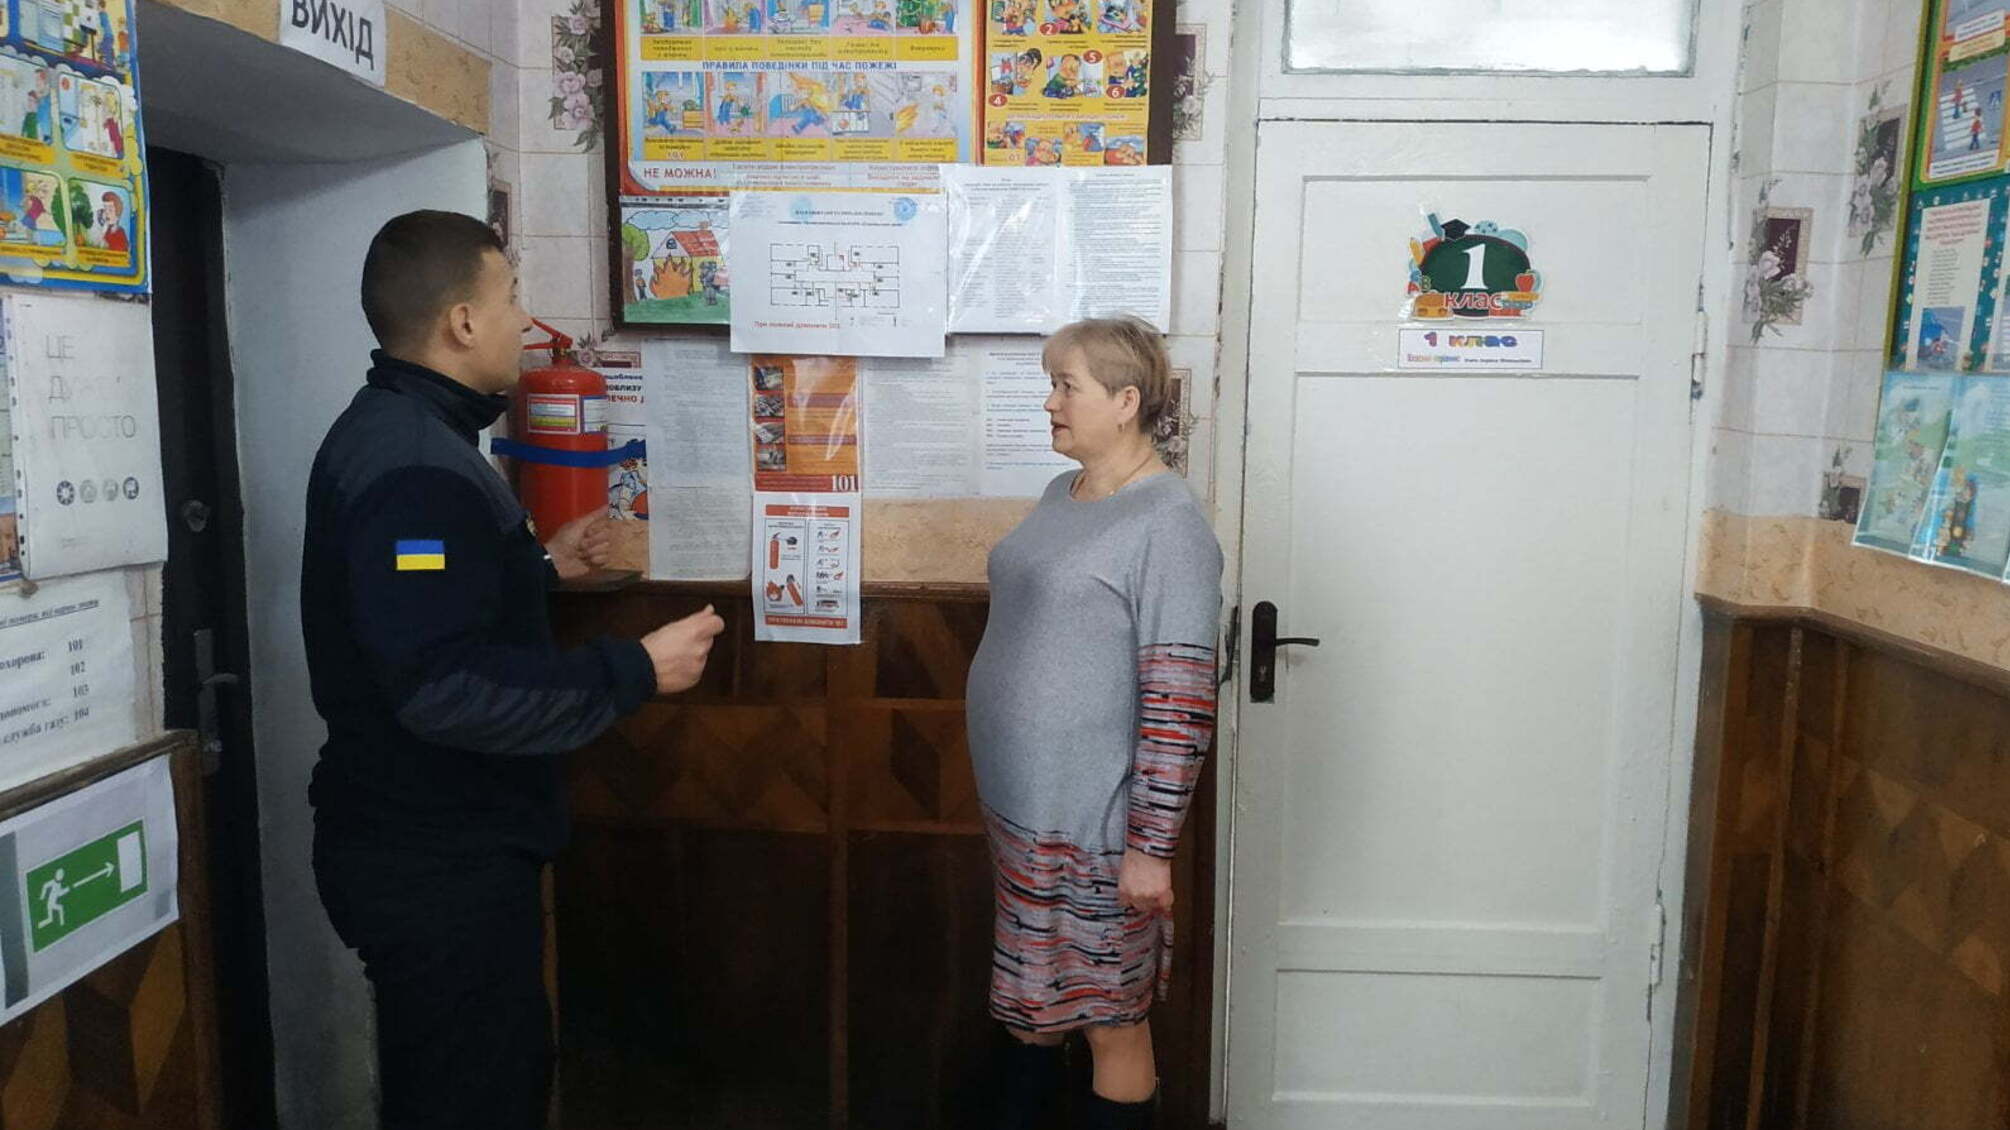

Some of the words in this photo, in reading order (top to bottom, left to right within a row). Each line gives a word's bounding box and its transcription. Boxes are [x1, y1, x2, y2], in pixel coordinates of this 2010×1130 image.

[292, 0, 374, 71] ВИХІД
[1046, 24, 1053, 34] 2
[1088, 52, 1098, 62] 5
[703, 61, 748, 70] ПРАВИЛА
[752, 61, 808, 71] ПОВЕДІНКИ
[812, 61, 828, 71] ПІД
[832, 61, 851, 70] ЧАС
[855, 61, 897, 70] ПОЖЕЖІ
[1111, 87, 1119, 97] 6
[994, 95, 1002, 105] 4
[644, 168, 660, 178] НЕ
[664, 167, 717, 179] МОЖНА!
[1460, 243, 1489, 290] 1
[1443, 292, 1506, 310] клас
[1424, 331, 1438, 348] 1
[1449, 335, 1518, 348] клас
[831, 474, 857, 492] 101
[68, 639, 84, 652] 101
[71, 661, 86, 675] 102
[73, 684, 89, 698] 103
[74, 707, 89, 721] 104
